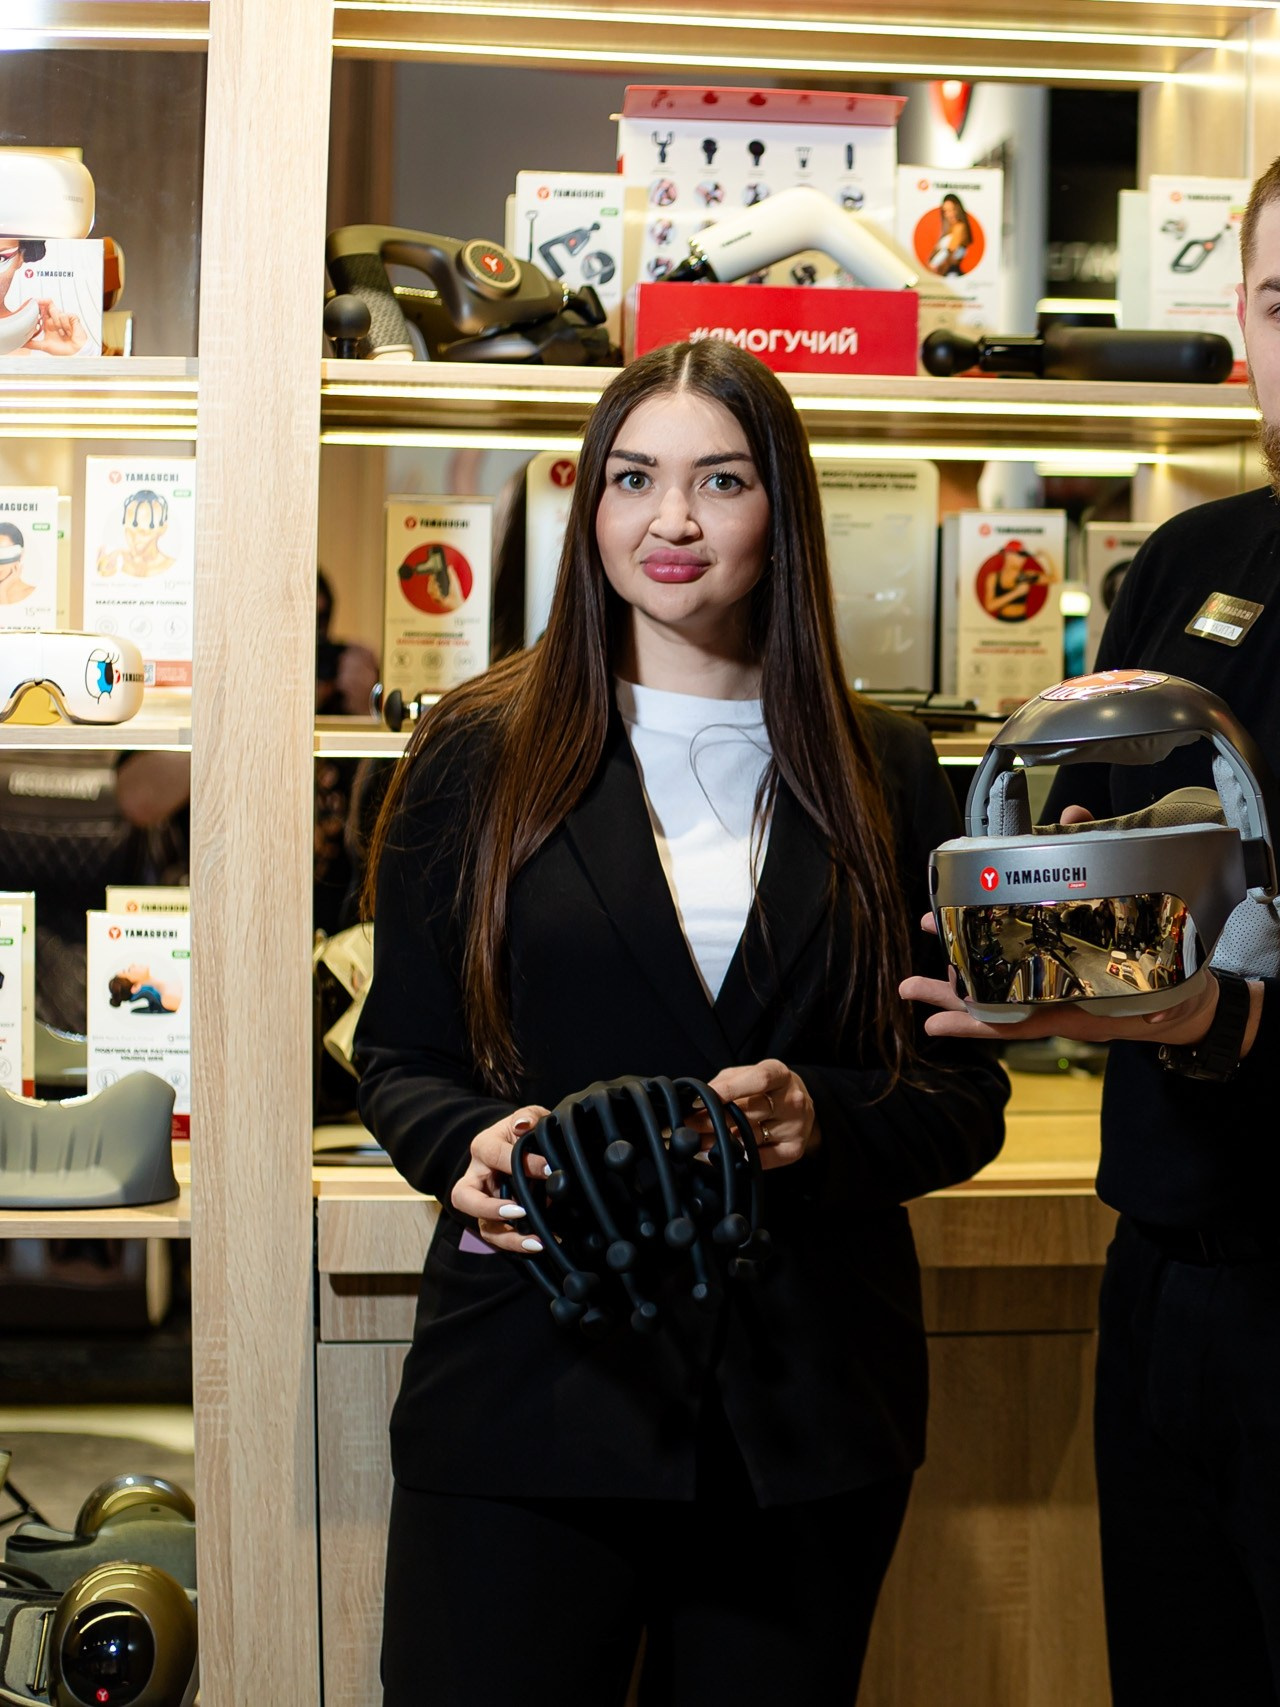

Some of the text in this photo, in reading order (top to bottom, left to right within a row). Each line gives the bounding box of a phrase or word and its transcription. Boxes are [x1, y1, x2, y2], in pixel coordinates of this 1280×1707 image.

[125, 473, 179, 482] YAMAGUCHI
[1005, 867, 1087, 885] YAMAGUCHI
[125, 930, 178, 938] YAMAGUCHI
